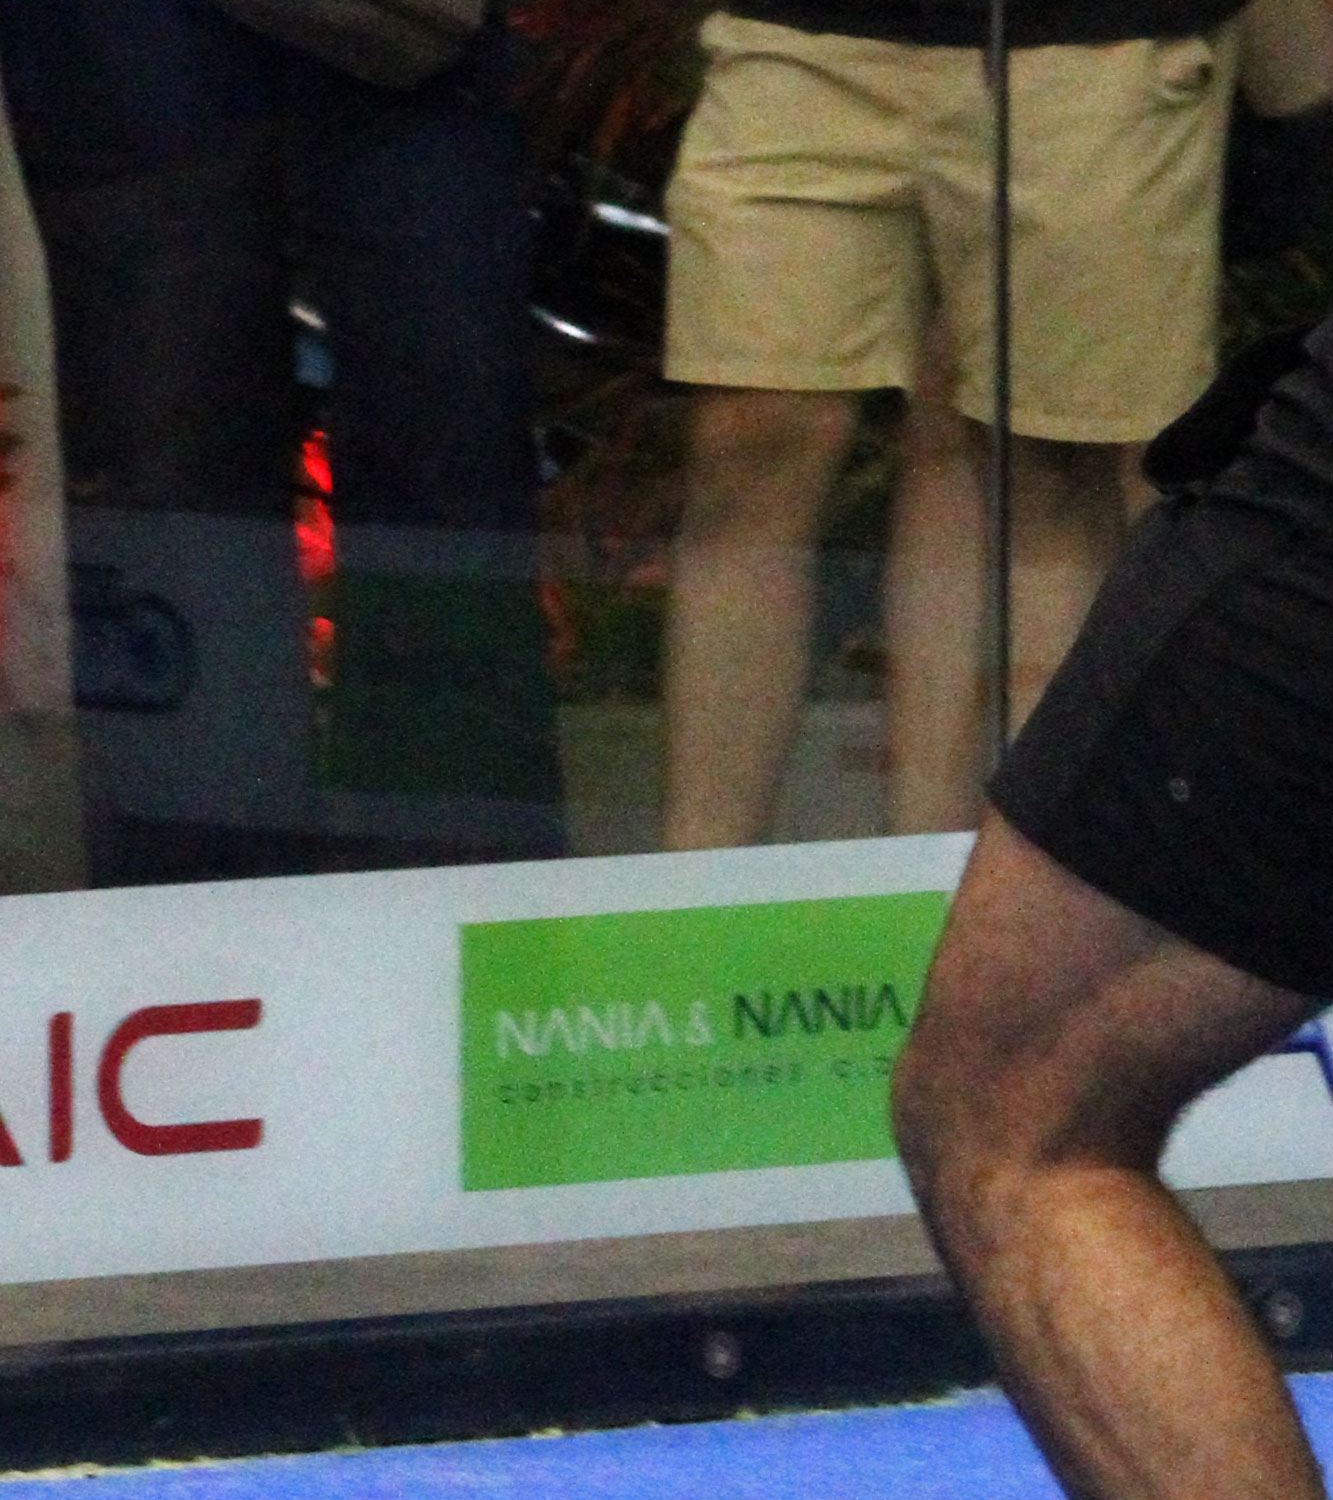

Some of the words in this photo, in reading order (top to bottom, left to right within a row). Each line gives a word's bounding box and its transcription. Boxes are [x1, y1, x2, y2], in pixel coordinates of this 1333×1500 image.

[494, 999, 674, 1058] NANIA
[684, 999, 716, 1046] &
[733, 983, 907, 1039] NANIA
[0, 998, 263, 1167] IC
